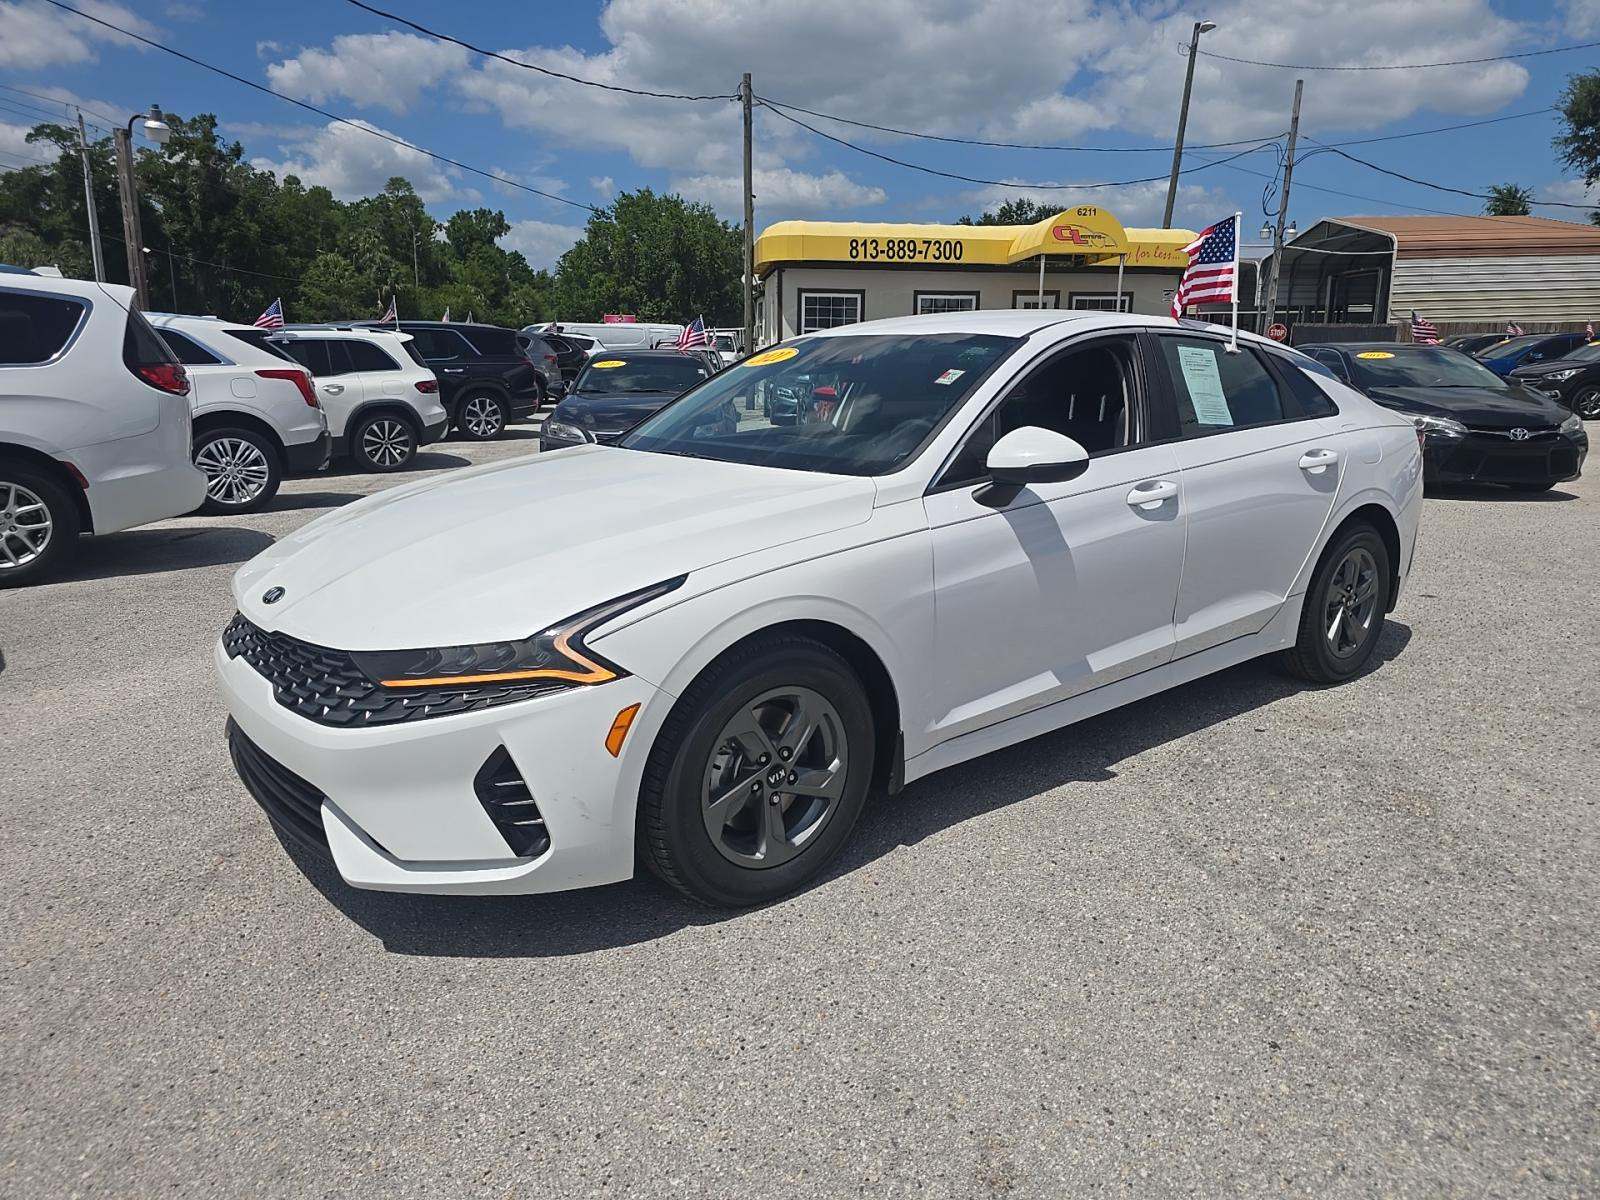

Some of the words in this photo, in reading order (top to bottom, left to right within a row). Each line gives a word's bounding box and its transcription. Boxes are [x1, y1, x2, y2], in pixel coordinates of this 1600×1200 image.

[1077, 208, 1097, 216] 6211
[849, 238, 963, 261] 813-889-7300
[1135, 245, 1150, 263] for
[1269, 328, 1285, 336] STOP
[768, 769, 786, 784] KIA
